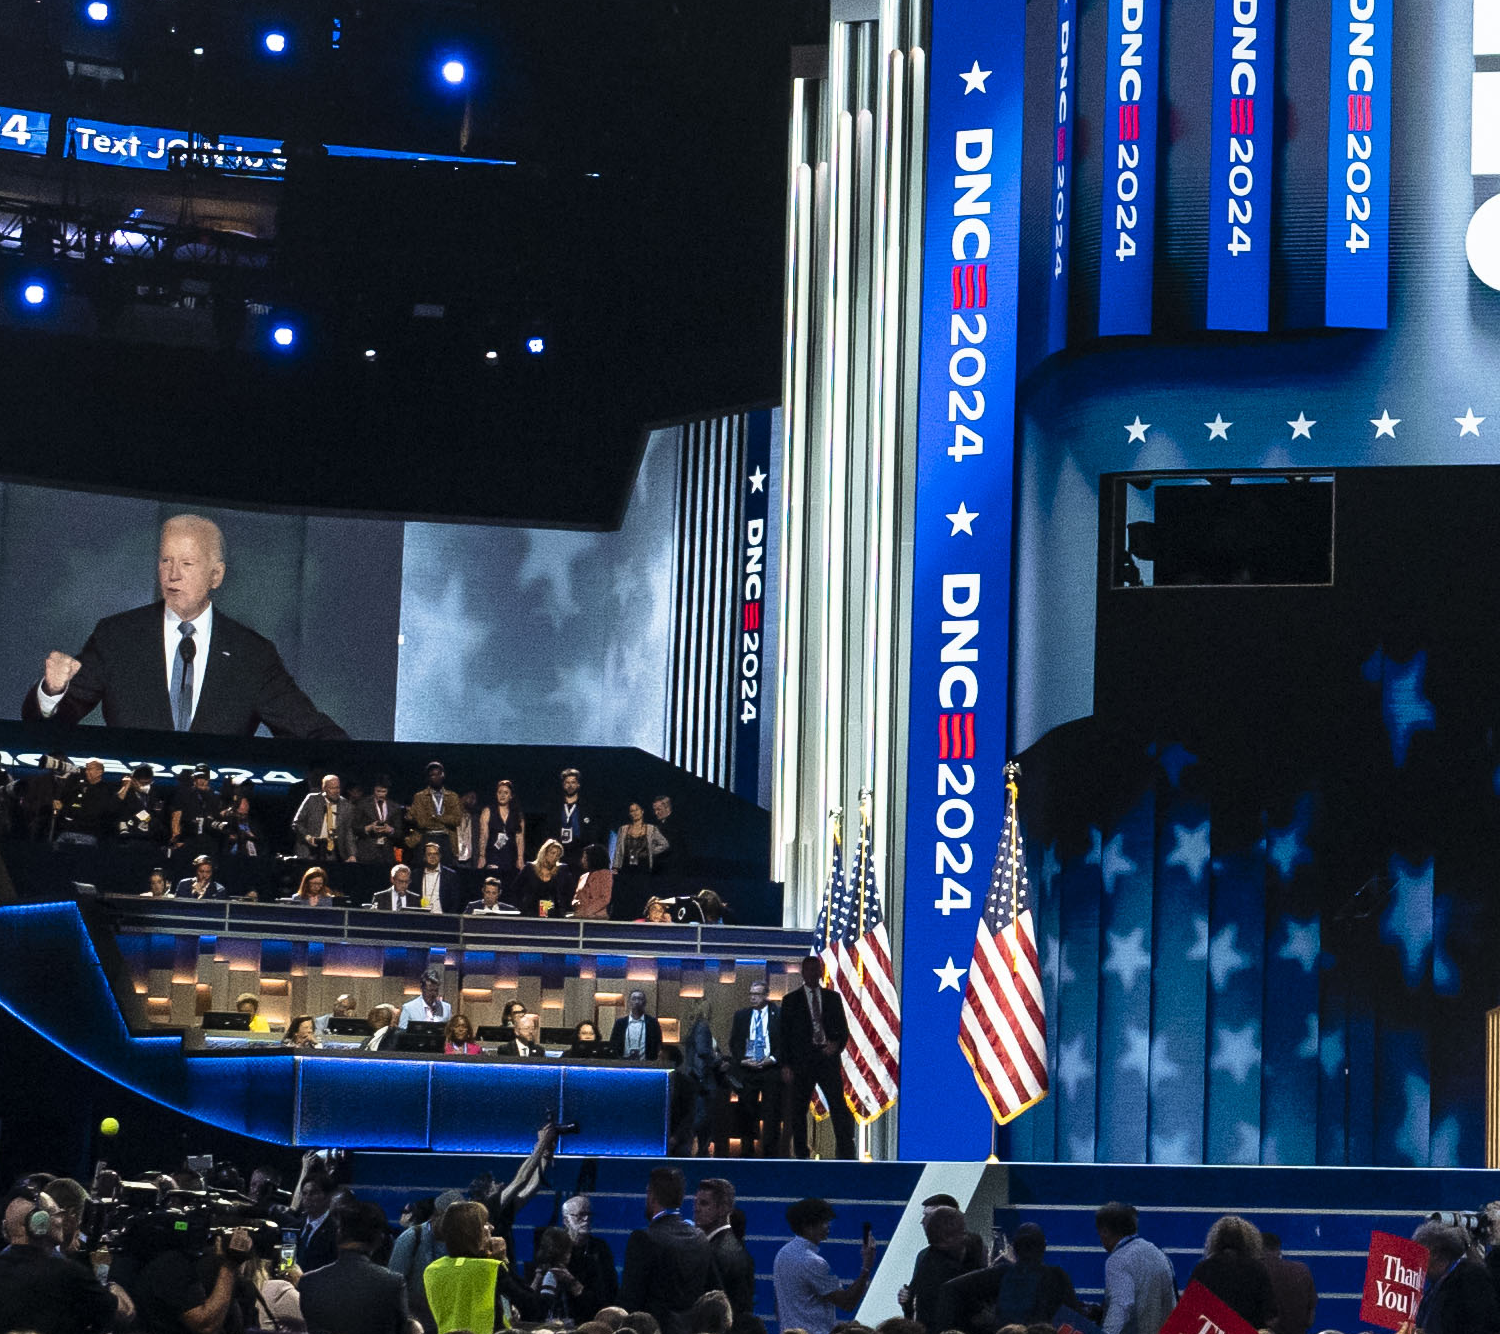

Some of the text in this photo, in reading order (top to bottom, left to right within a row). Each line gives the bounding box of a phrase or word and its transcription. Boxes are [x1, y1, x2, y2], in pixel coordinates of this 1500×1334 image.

[75, 127, 142, 157] Text
[1052, 18, 1071, 282] DNC 2024
[1227, 137, 1254, 257] 2024
[1345, 133, 1372, 254] 2024
[1115, 144, 1139, 262] 2024
[947, 128, 993, 463] DNC 2024
[740, 518, 764, 724] DNC 2024
[934, 573, 981, 916] DNC 2024
[1375, 1280, 1409, 1314] You
